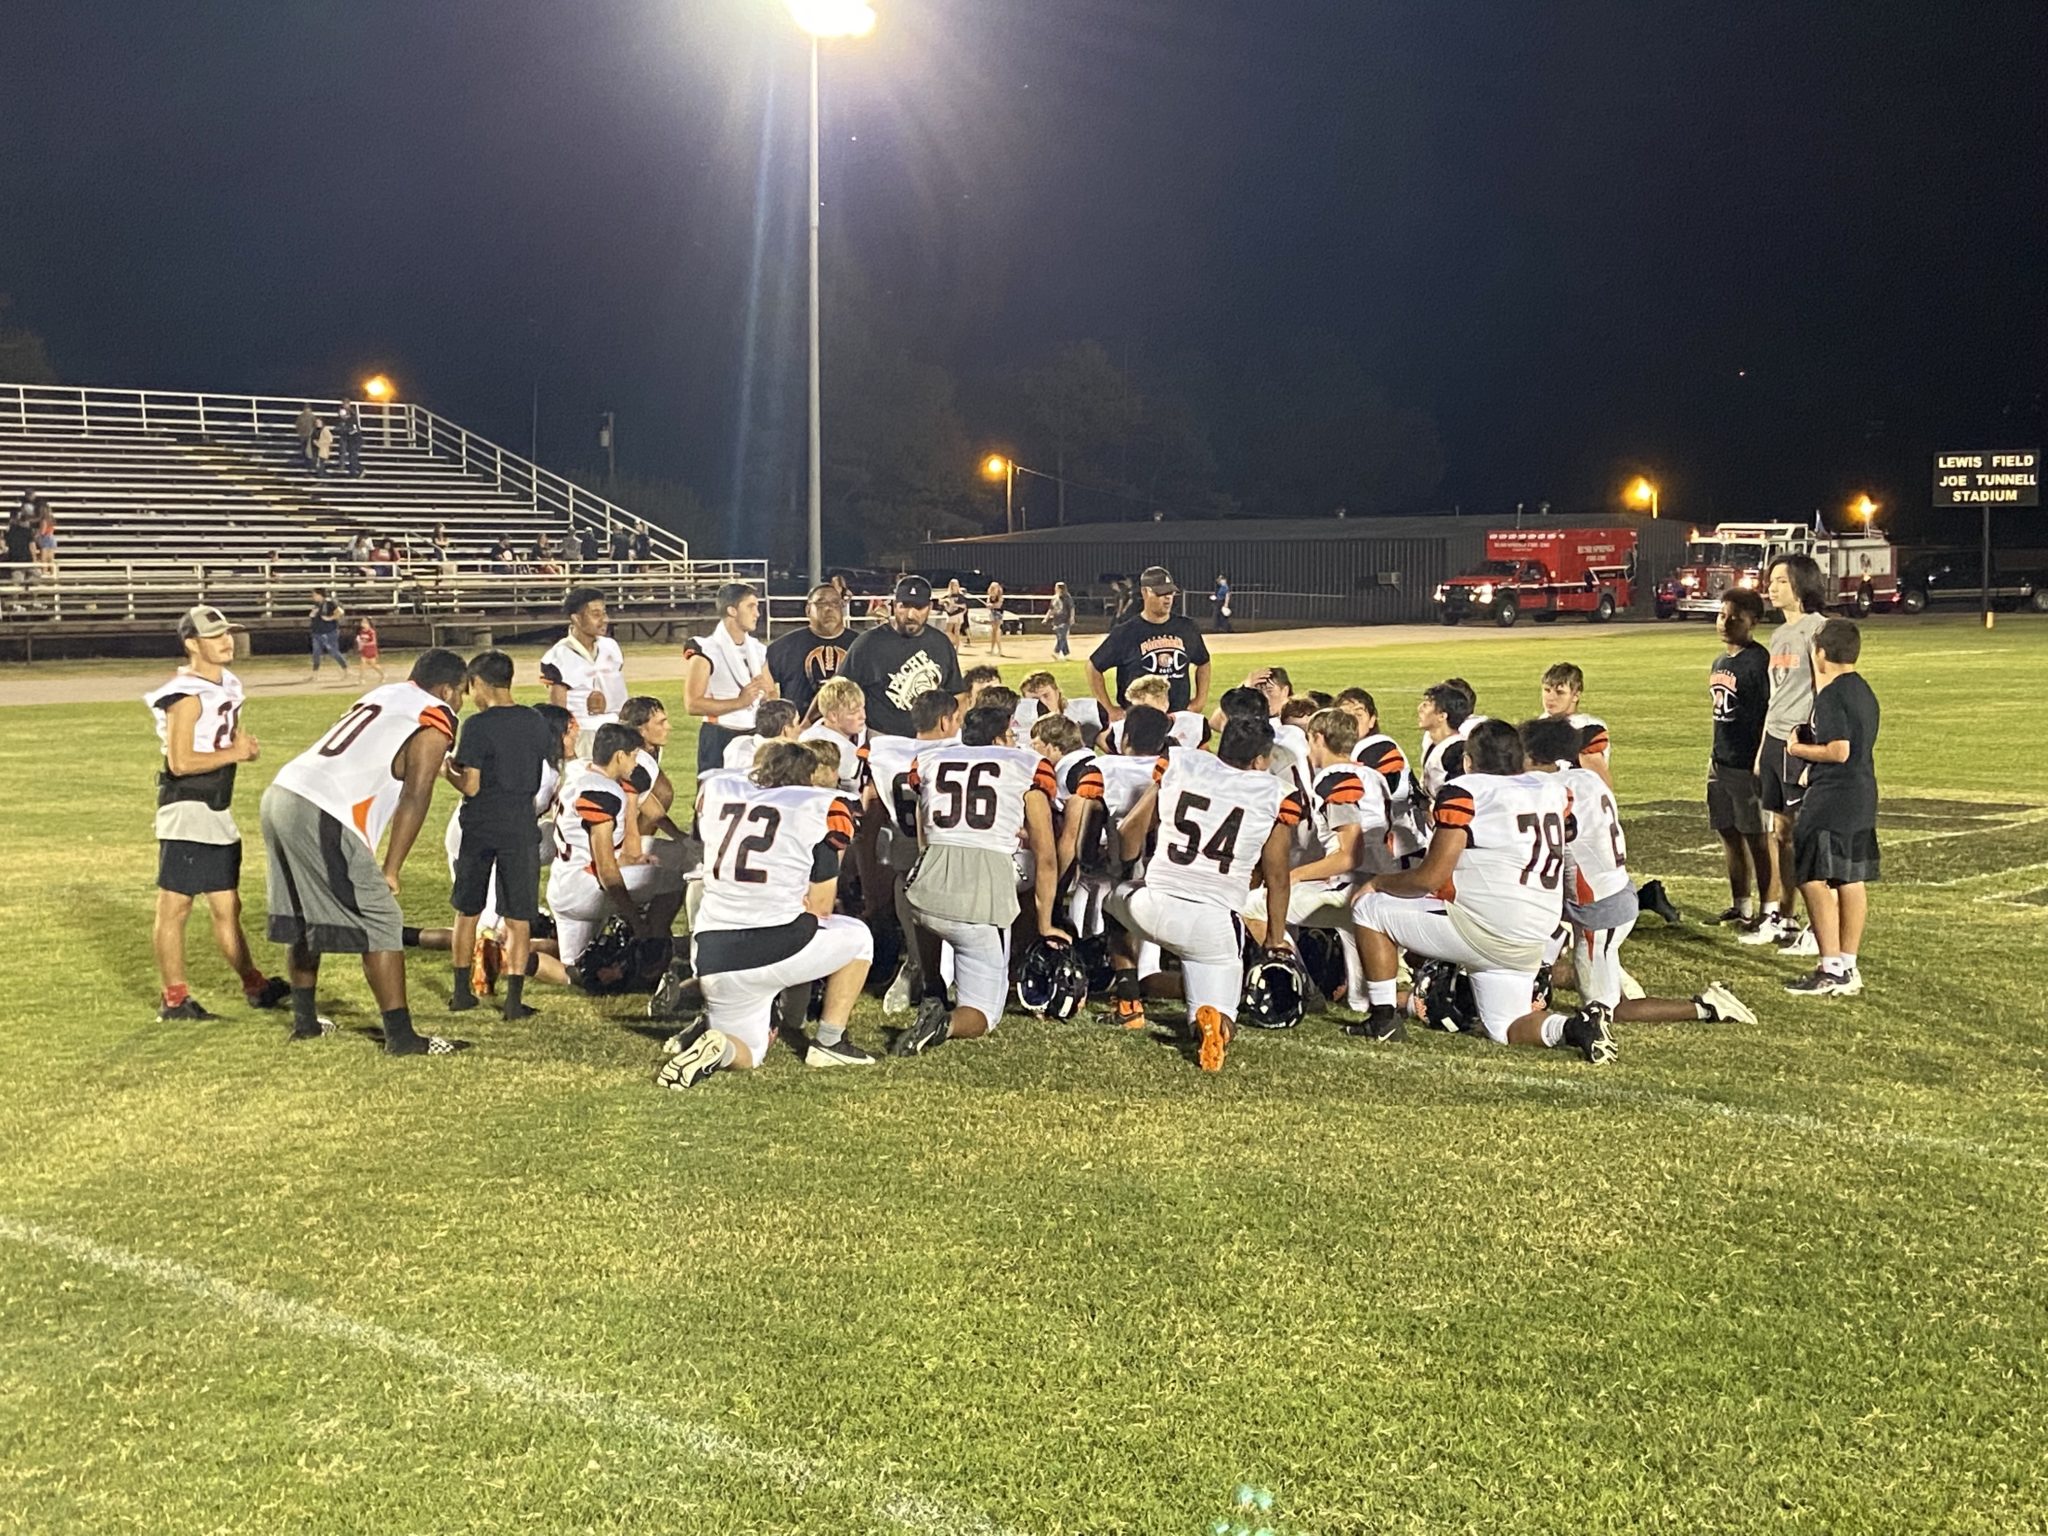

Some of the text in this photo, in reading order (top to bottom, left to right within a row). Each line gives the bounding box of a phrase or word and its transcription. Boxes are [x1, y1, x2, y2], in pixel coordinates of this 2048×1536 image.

[1938, 455, 2034, 468] LEWIS FIELD
[1939, 474, 2036, 487] JOE TUNNELL
[1952, 490, 2018, 502] STADIUM
[885, 649, 933, 710] APACHE
[318, 703, 382, 757] 0
[932, 761, 1001, 830] 56
[713, 803, 781, 883] 72
[1167, 790, 1245, 875] 54
[1516, 812, 1563, 890] 78
